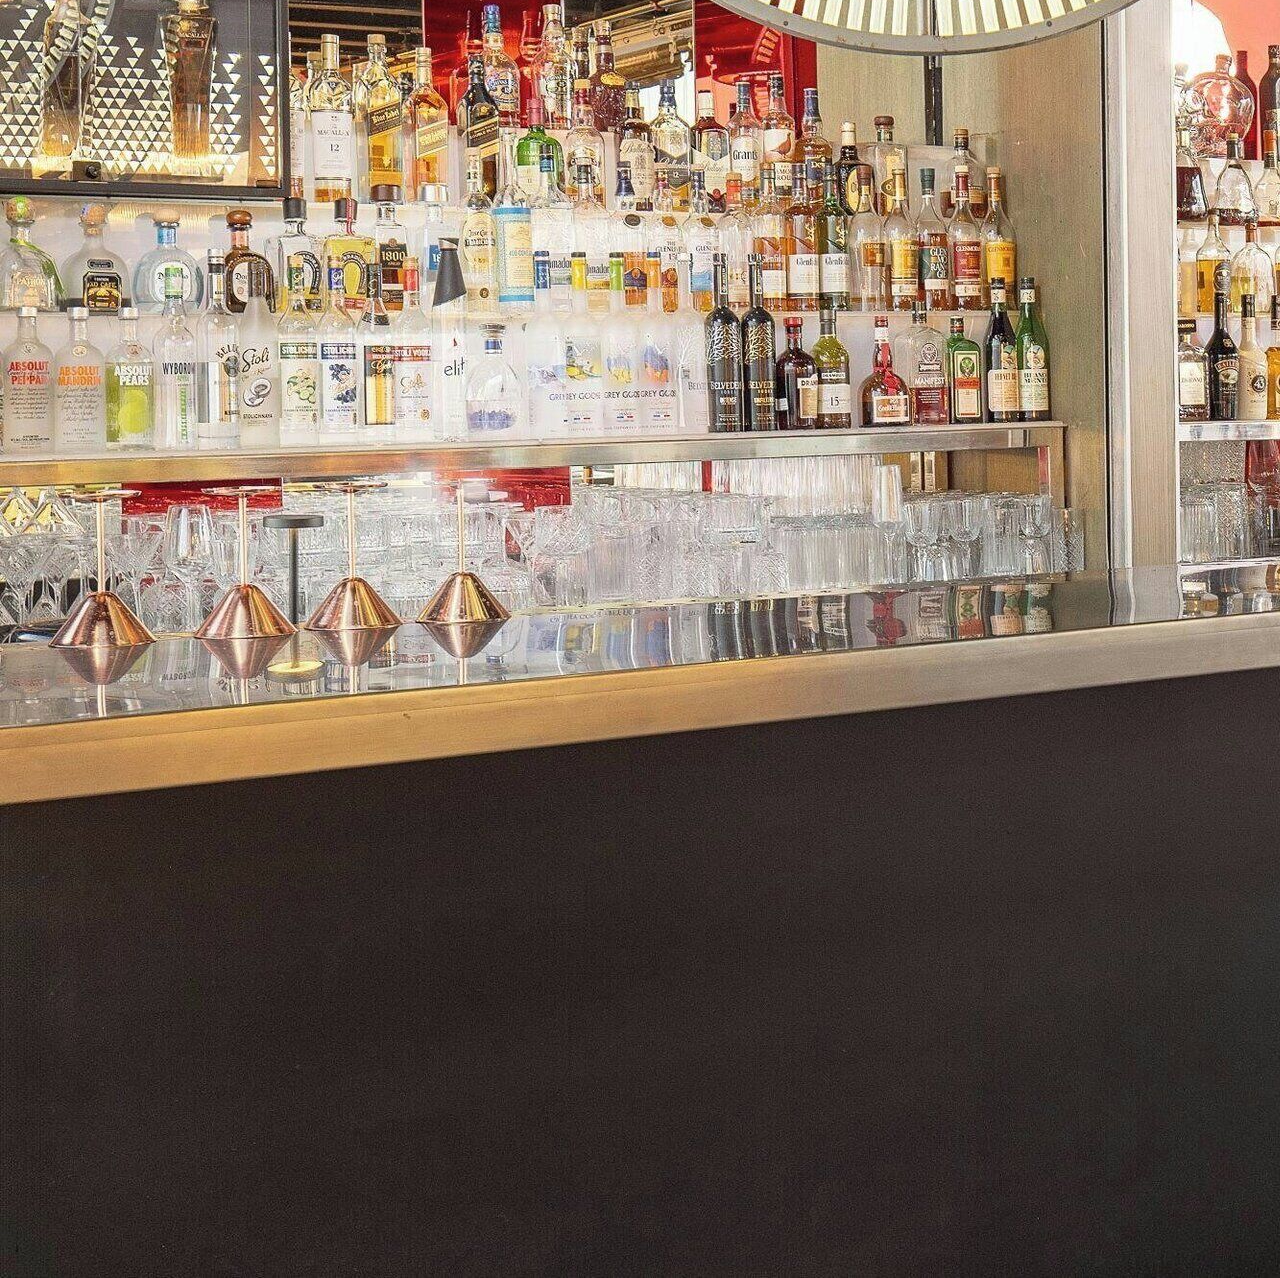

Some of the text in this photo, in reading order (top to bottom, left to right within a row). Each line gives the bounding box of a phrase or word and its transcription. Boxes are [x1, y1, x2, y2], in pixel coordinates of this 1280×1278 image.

[329, 143, 340, 152] 12
[381, 250, 406, 262] 1800
[241, 347, 270, 373] Stoli
[9, 361, 49, 371] ABSOLUT
[59, 365, 100, 376] ABSOLUT
[114, 365, 153, 377] ABSOLUT
[57, 375, 102, 387] MANDRIN
[119, 375, 149, 386] PEARS
[914, 377, 945, 385] MANIFEST
[1253, 377, 1265, 391] 43
[830, 396, 840, 407] 15
